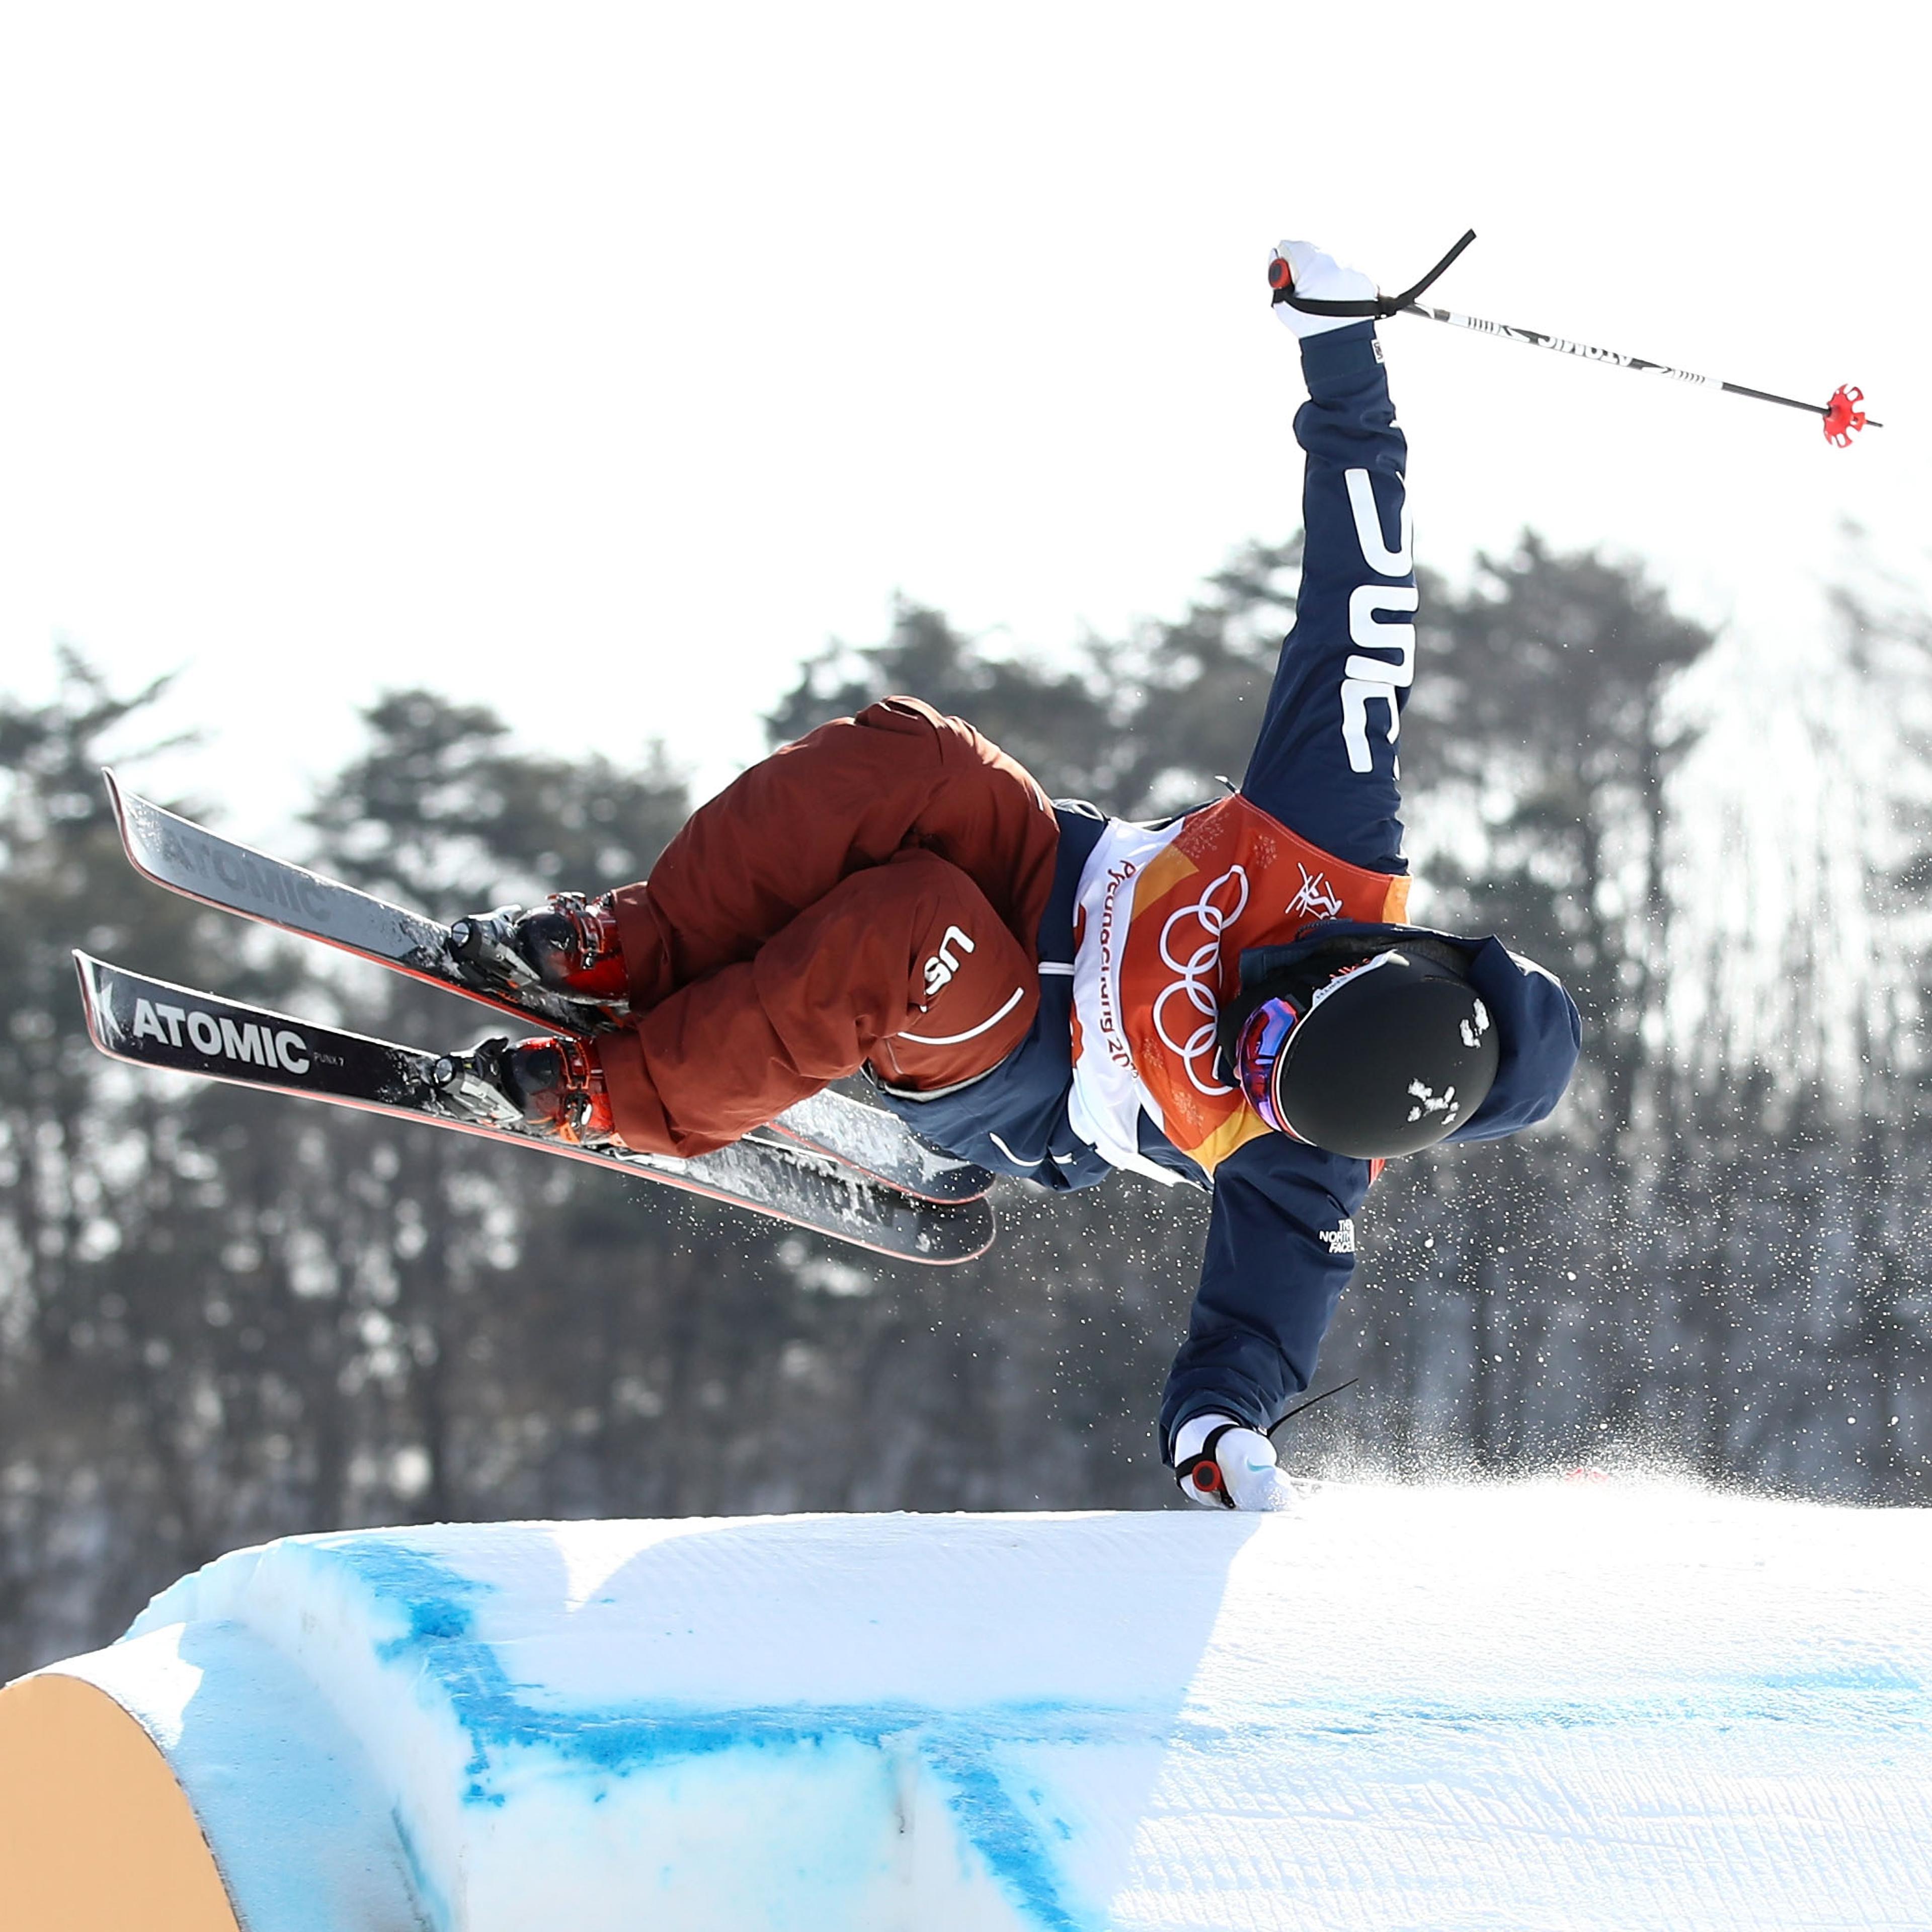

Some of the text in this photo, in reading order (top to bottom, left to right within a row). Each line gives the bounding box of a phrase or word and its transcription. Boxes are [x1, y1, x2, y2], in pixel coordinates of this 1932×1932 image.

[163, 828, 332, 922] ATOMIC
[920, 926, 975, 1012] US
[133, 997, 310, 1074] ATOMIC
[1319, 1231, 1350, 1243] NORTH
[1329, 1242, 1352, 1253] FACE
